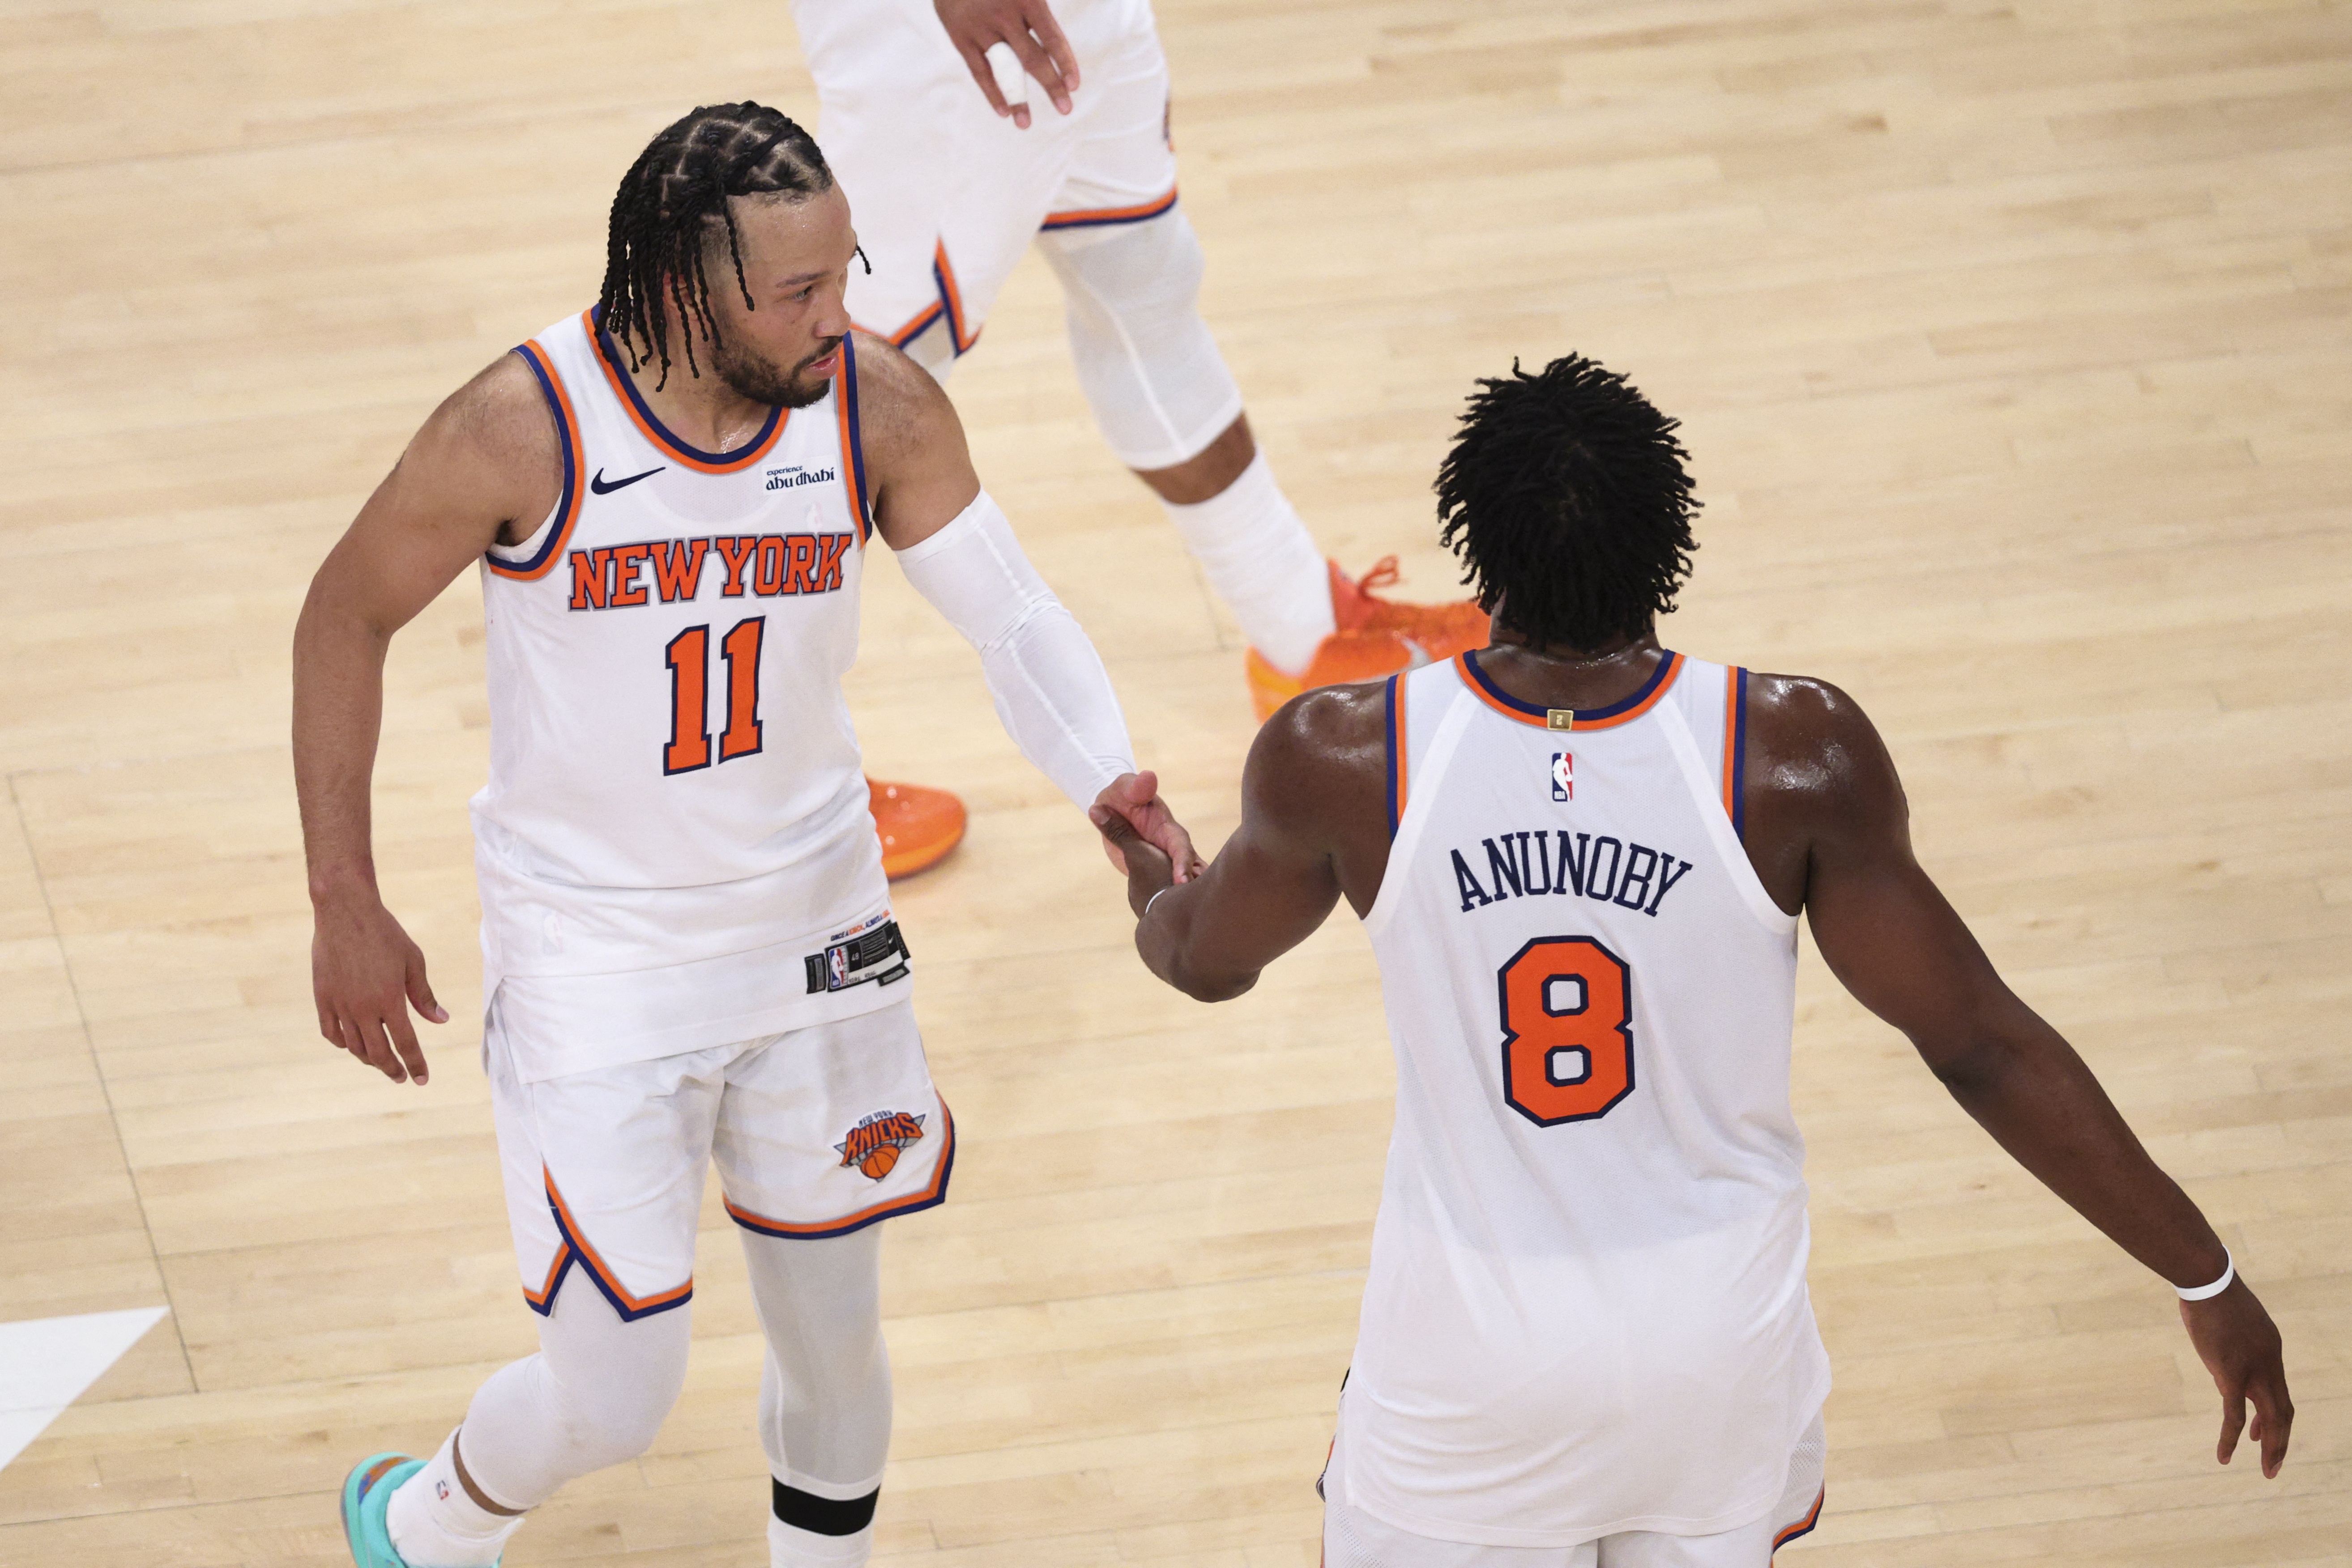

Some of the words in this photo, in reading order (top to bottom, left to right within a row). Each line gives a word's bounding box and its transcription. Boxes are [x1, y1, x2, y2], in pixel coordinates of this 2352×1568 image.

[766, 476, 794, 490] abu
[796, 467, 835, 486] dhabi
[767, 465, 803, 476] experience
[568, 537, 710, 612] NEW
[714, 531, 856, 600] YORK
[663, 615, 766, 776] 11
[1554, 791, 1566, 800] NBA
[1450, 830, 1693, 917] ANUNOBY
[1497, 935, 1635, 1128] 8
[839, 1112, 924, 1167] KNICKS
[858, 1113, 874, 1127] NEW
[874, 1110, 894, 1120] YORK
